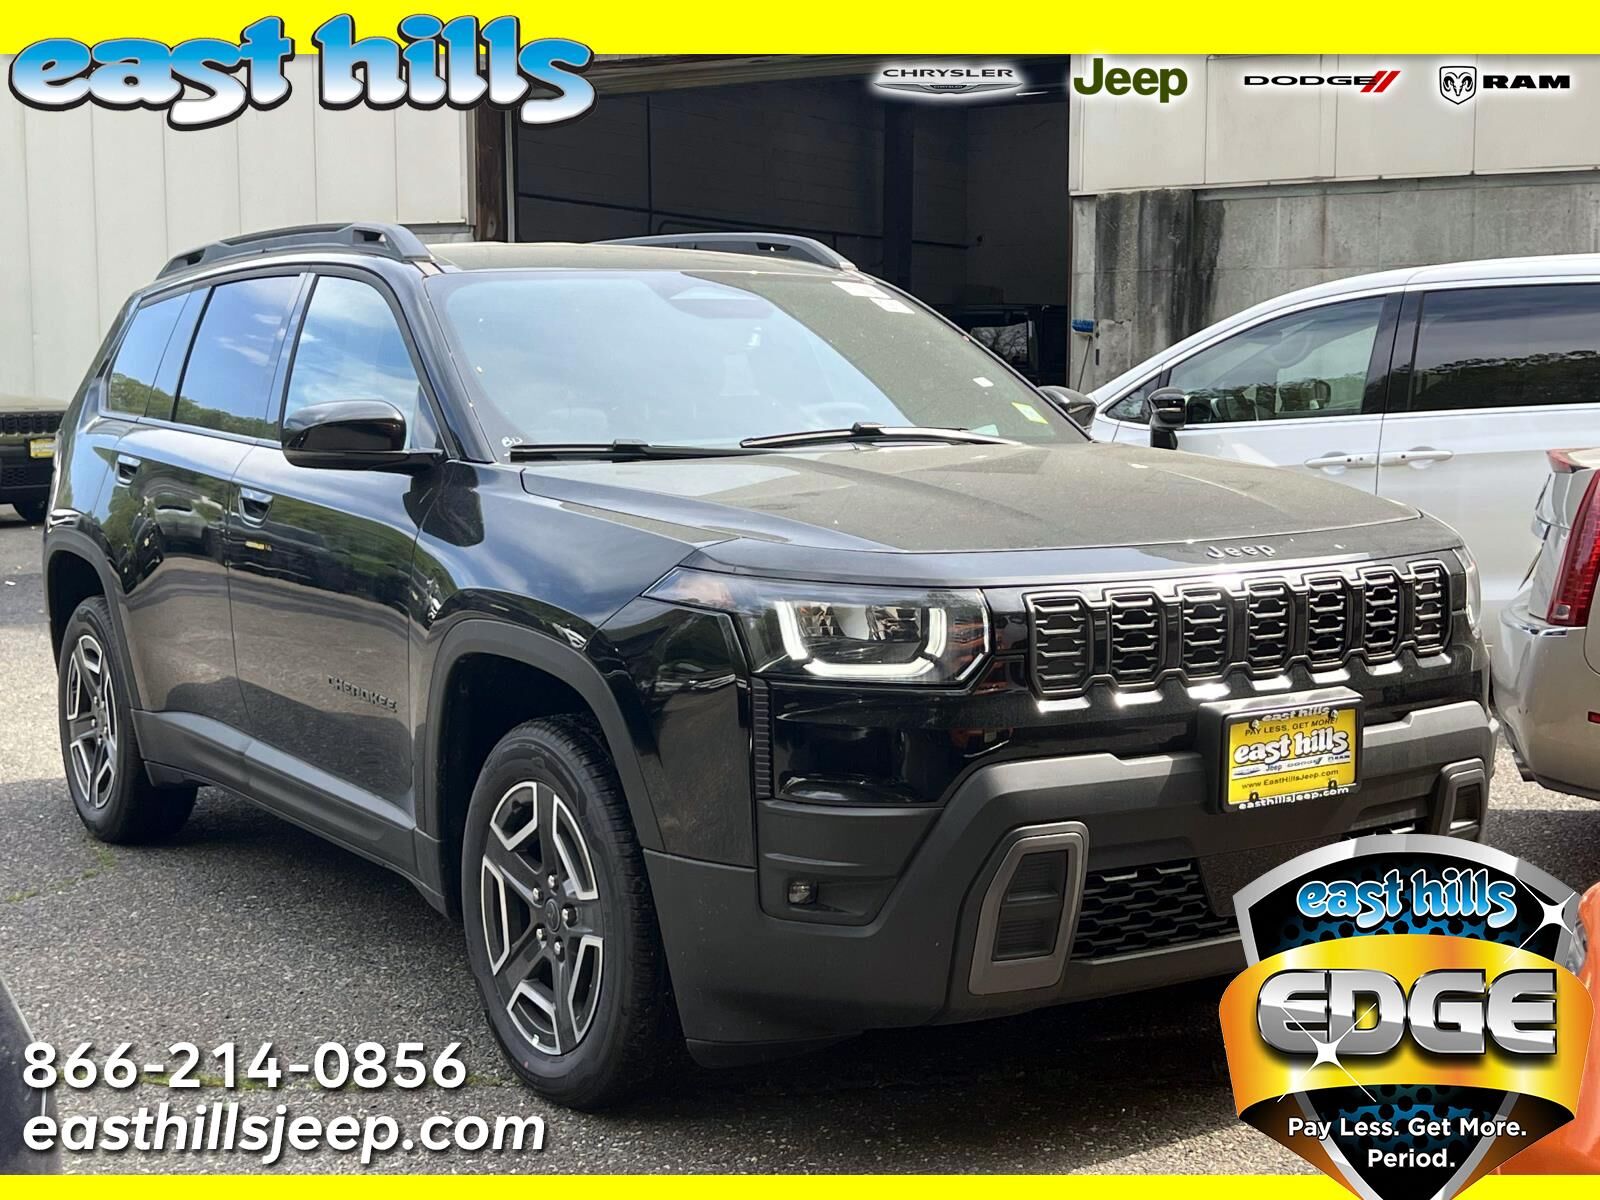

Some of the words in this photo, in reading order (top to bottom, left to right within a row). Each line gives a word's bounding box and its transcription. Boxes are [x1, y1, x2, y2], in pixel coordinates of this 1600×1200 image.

[1206, 544, 1276, 559] Jeep
[327, 674, 398, 714] CHEROKEE
[1244, 727, 1261, 737] PAY
[1292, 721, 1309, 730] GET
[1233, 732, 1292, 765] east
[1294, 727, 1350, 755] hills
[1238, 786, 1349, 810] easthillsjeep.com
